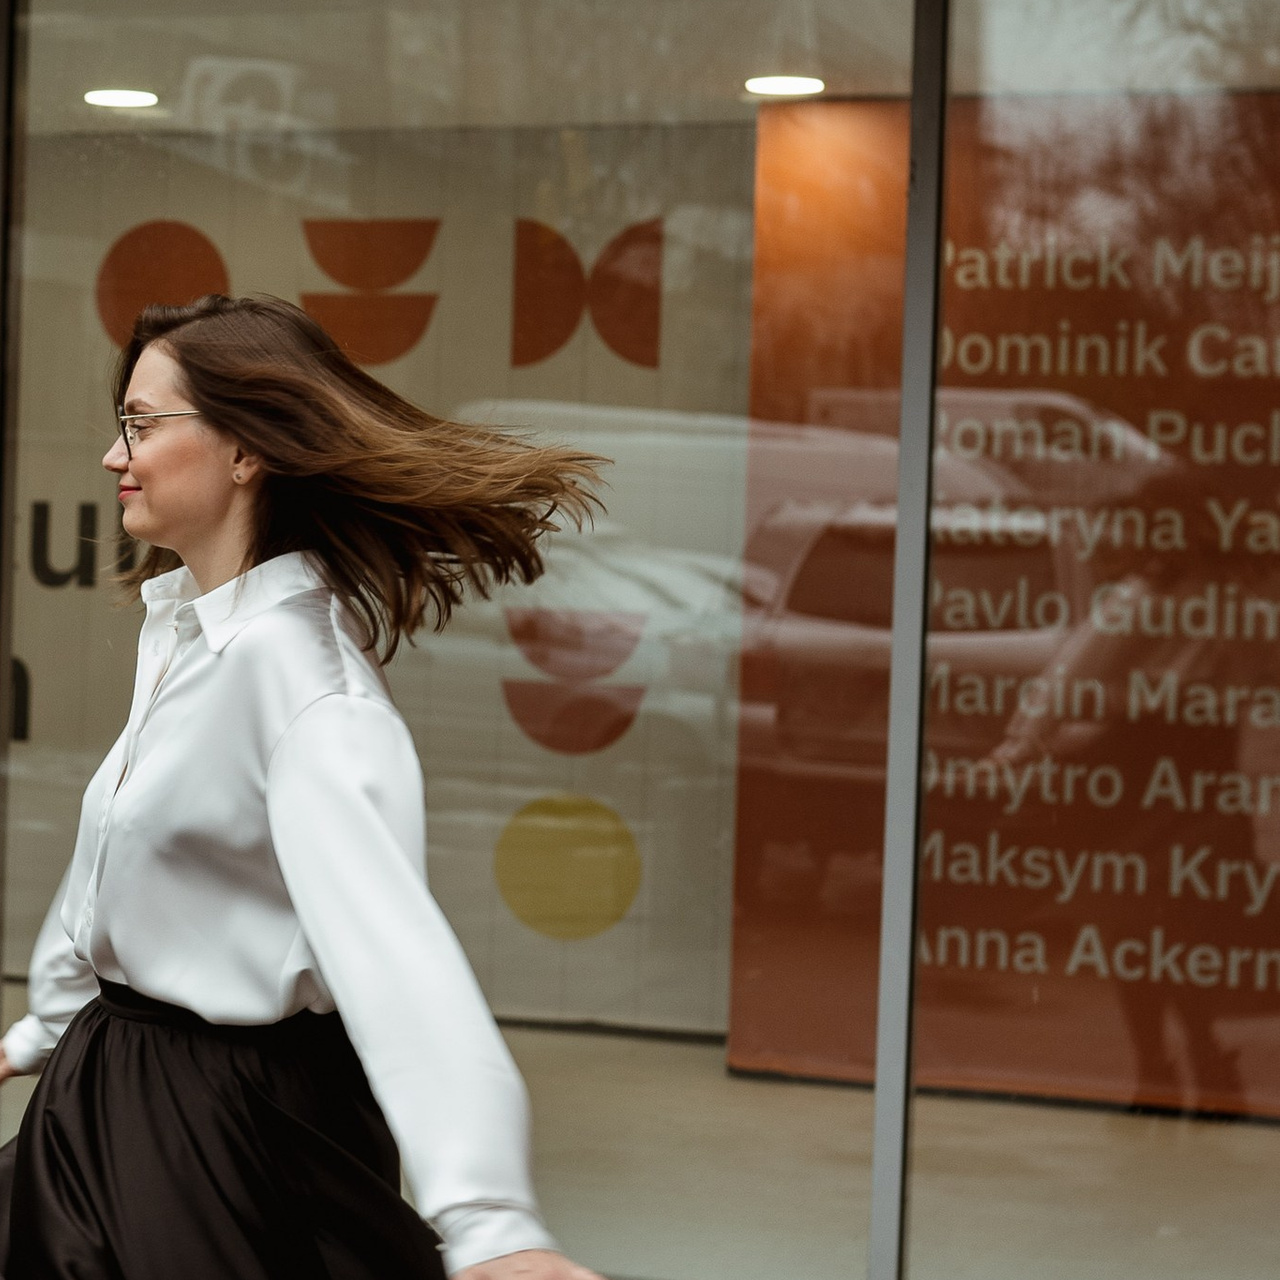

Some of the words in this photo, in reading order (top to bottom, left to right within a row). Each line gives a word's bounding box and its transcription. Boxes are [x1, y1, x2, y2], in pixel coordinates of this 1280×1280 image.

[1185, 323, 1280, 379] Ca
[931, 492, 1186, 561] ateryna
[928, 574, 1070, 632] avlo
